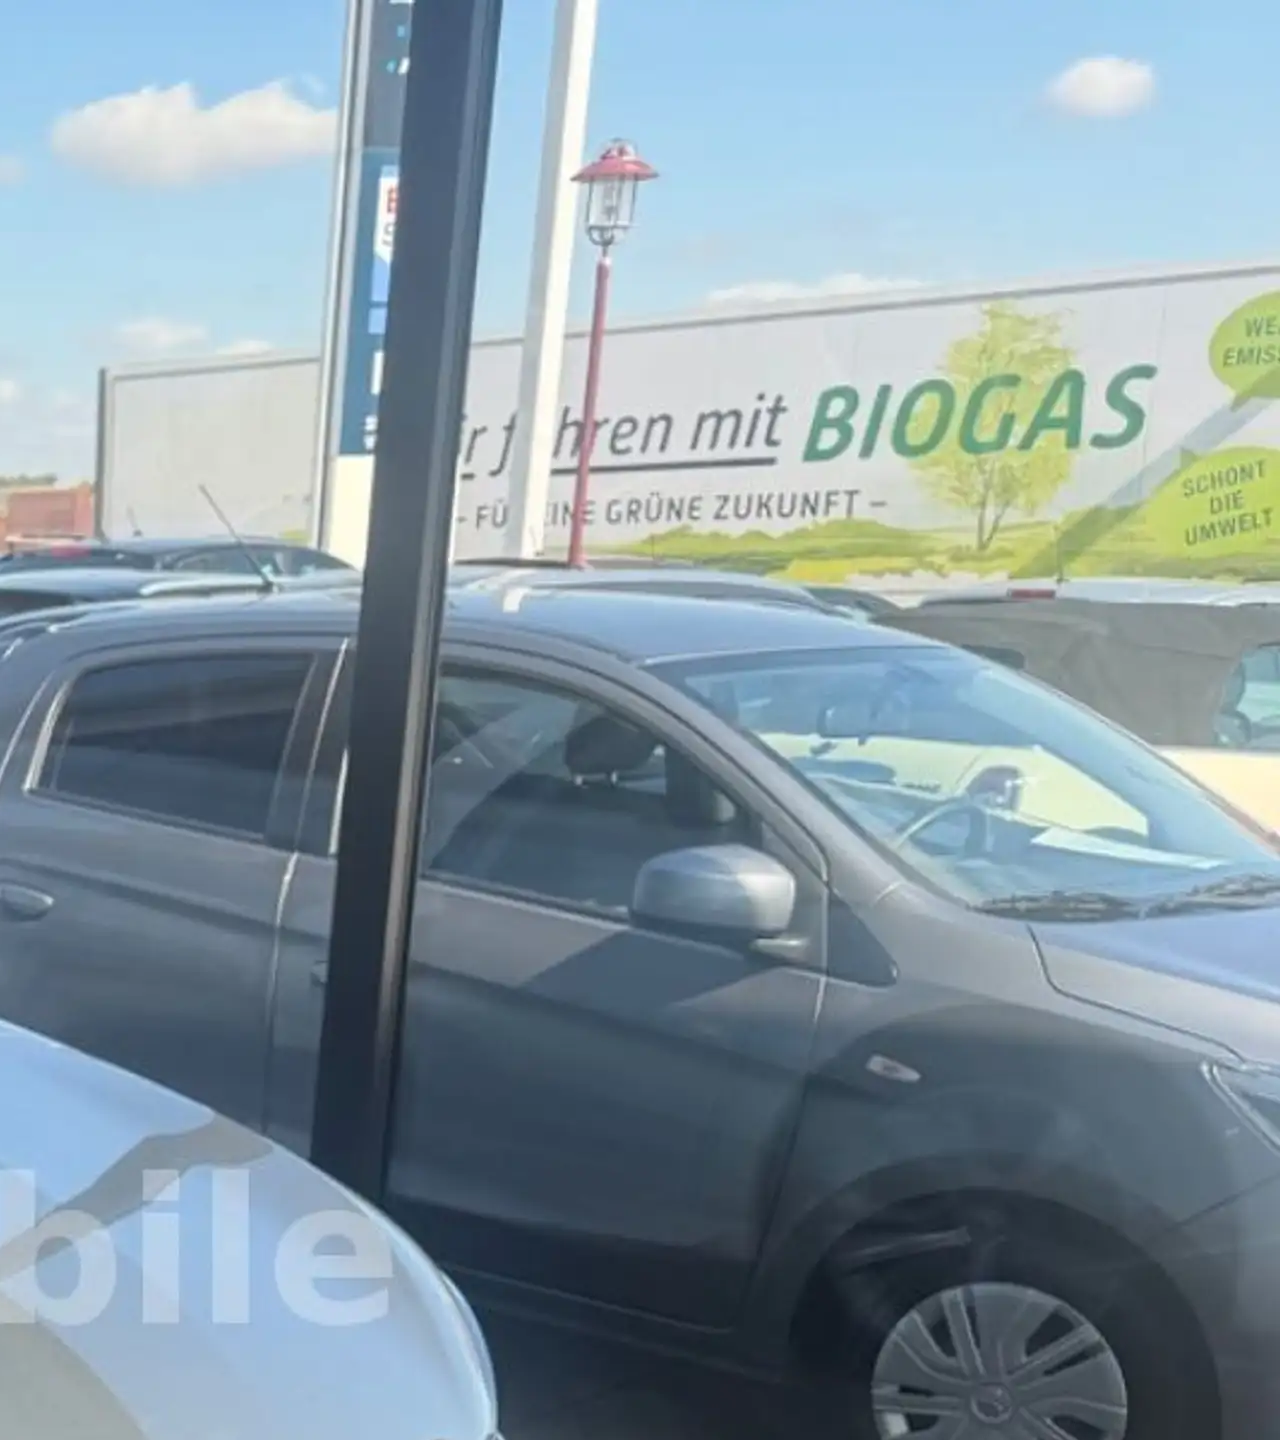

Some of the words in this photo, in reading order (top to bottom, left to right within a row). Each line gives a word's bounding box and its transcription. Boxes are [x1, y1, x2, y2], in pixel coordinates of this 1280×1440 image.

[1244, 315, 1280, 338] WE
[1222, 346, 1280, 368] EMIS
[488, 404, 674, 477] fhren
[690, 392, 789, 452] mit
[802, 364, 1158, 463] BIOGAS
[1182, 459, 1266, 498] SCHONT
[475, 499, 510, 529] FÜ
[605, 492, 704, 526] GRÜNE
[712, 488, 862, 521] ZUKUNFT
[1208, 489, 1245, 515] DIE
[1184, 507, 1272, 547] UMWELT
